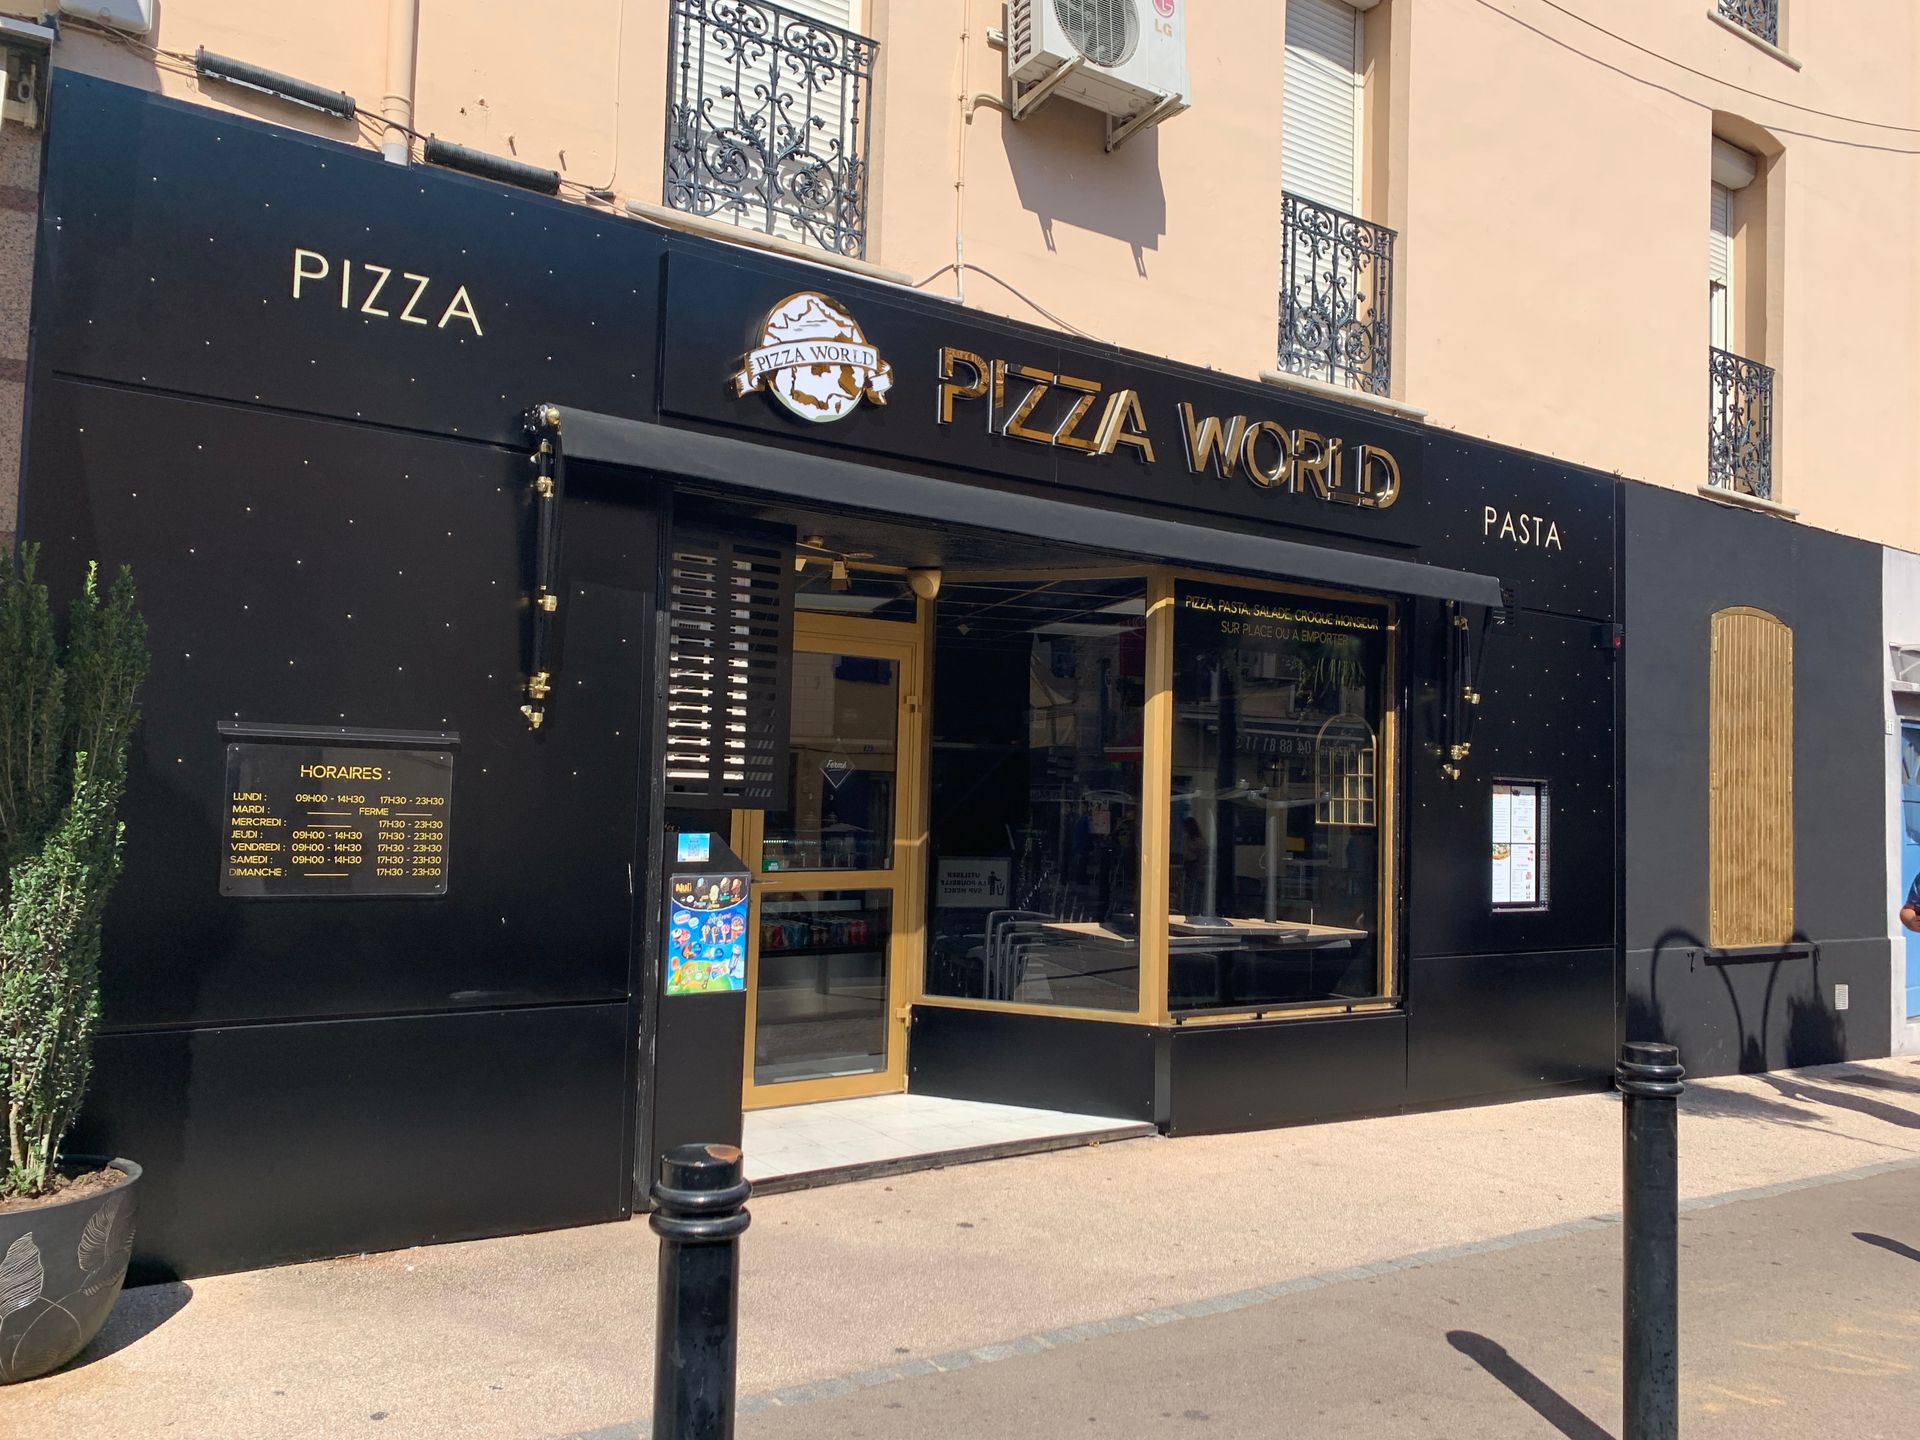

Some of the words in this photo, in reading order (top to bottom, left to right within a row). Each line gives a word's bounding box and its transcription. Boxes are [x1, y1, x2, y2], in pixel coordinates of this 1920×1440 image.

[1154, 18, 1173, 38] LG
[293, 248, 483, 336] PIZZA
[756, 347, 805, 371] PIZZA
[810, 346, 875, 366] WORLD
[937, 346, 1156, 464] PIZZA
[1176, 402, 1401, 510] WORLD
[1484, 505, 1562, 551] PASTA
[1221, 620, 1240, 634] SUR
[1242, 623, 1273, 638] PLACE
[1275, 627, 1290, 640] OU
[1301, 630, 1349, 646] EMPORTER
[300, 765, 382, 780] HORAIRES
[233, 792, 262, 801] LUNDI
[295, 794, 328, 803] 09H00
[337, 795, 365, 804] 14H30
[380, 796, 407, 804] 17H30
[415, 797, 445, 805] 23H30
[232, 805, 265, 814] MARDI
[359, 807, 389, 816] FERME
[231, 817, 282, 827] MERCREDI
[379, 820, 406, 829] 17H30
[414, 820, 444, 829] 23H30
[231, 830, 258, 839] JEUDI
[292, 830, 325, 840] 09H00
[335, 831, 363, 840] 14H30
[378, 832, 405, 840] 17H30
[413, 832, 443, 841] 23H30
[230, 843, 281, 852] VENDREDI
[291, 843, 325, 852] 09H00
[333, 843, 362, 852] 14H30
[377, 844, 404, 853] 17H30
[412, 844, 442, 853] 23H30
[229, 855, 268, 864] SAMEDI
[291, 855, 325, 864] 09H00
[333, 856, 362, 865] 14H30
[376, 856, 404, 865] 17H30
[412, 856, 442, 865] 23H30
[228, 868, 282, 877] DIMANCHE
[376, 868, 404, 877] 17H30
[411, 868, 441, 877] 23H30
